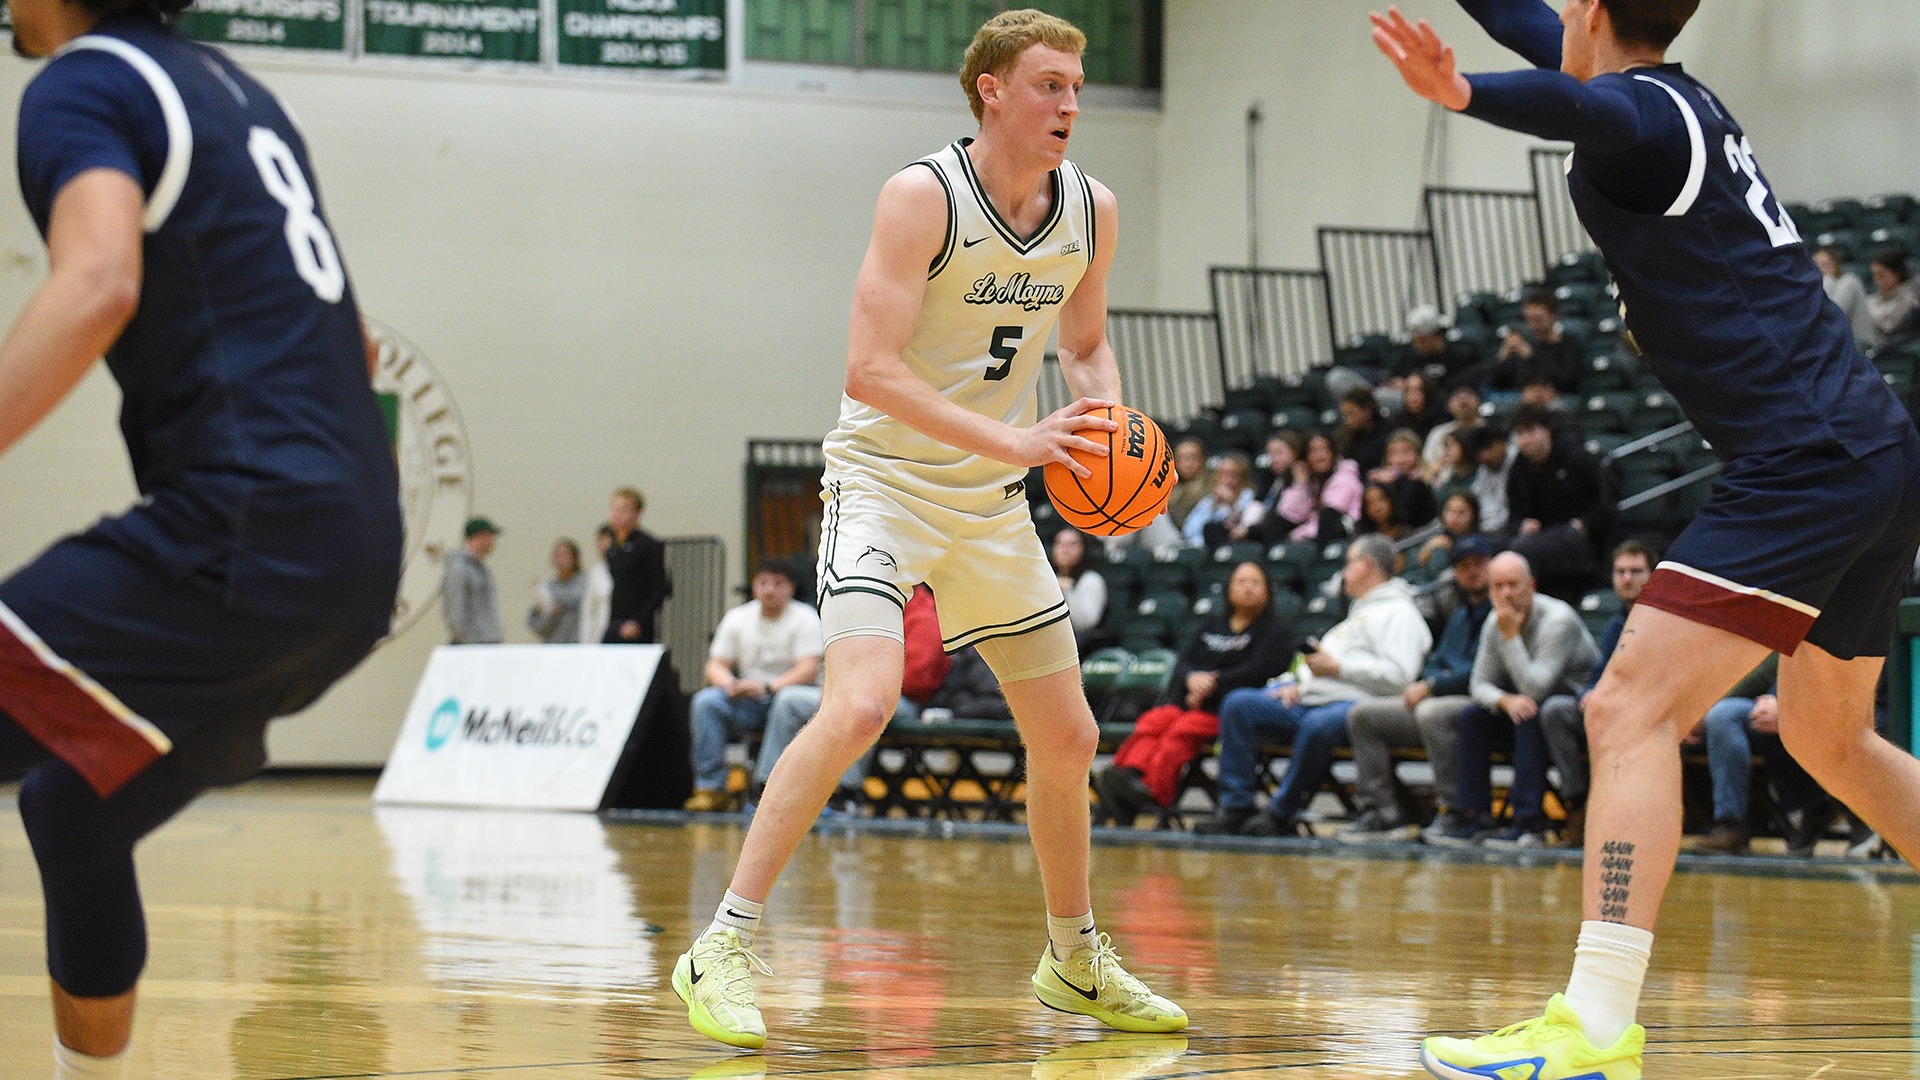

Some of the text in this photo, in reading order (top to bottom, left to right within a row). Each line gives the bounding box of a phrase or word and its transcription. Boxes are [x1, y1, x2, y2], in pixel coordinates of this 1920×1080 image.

[248, 125, 346, 303] 8
[983, 326, 1024, 381] 5
[1126, 410, 1145, 458] NCAA
